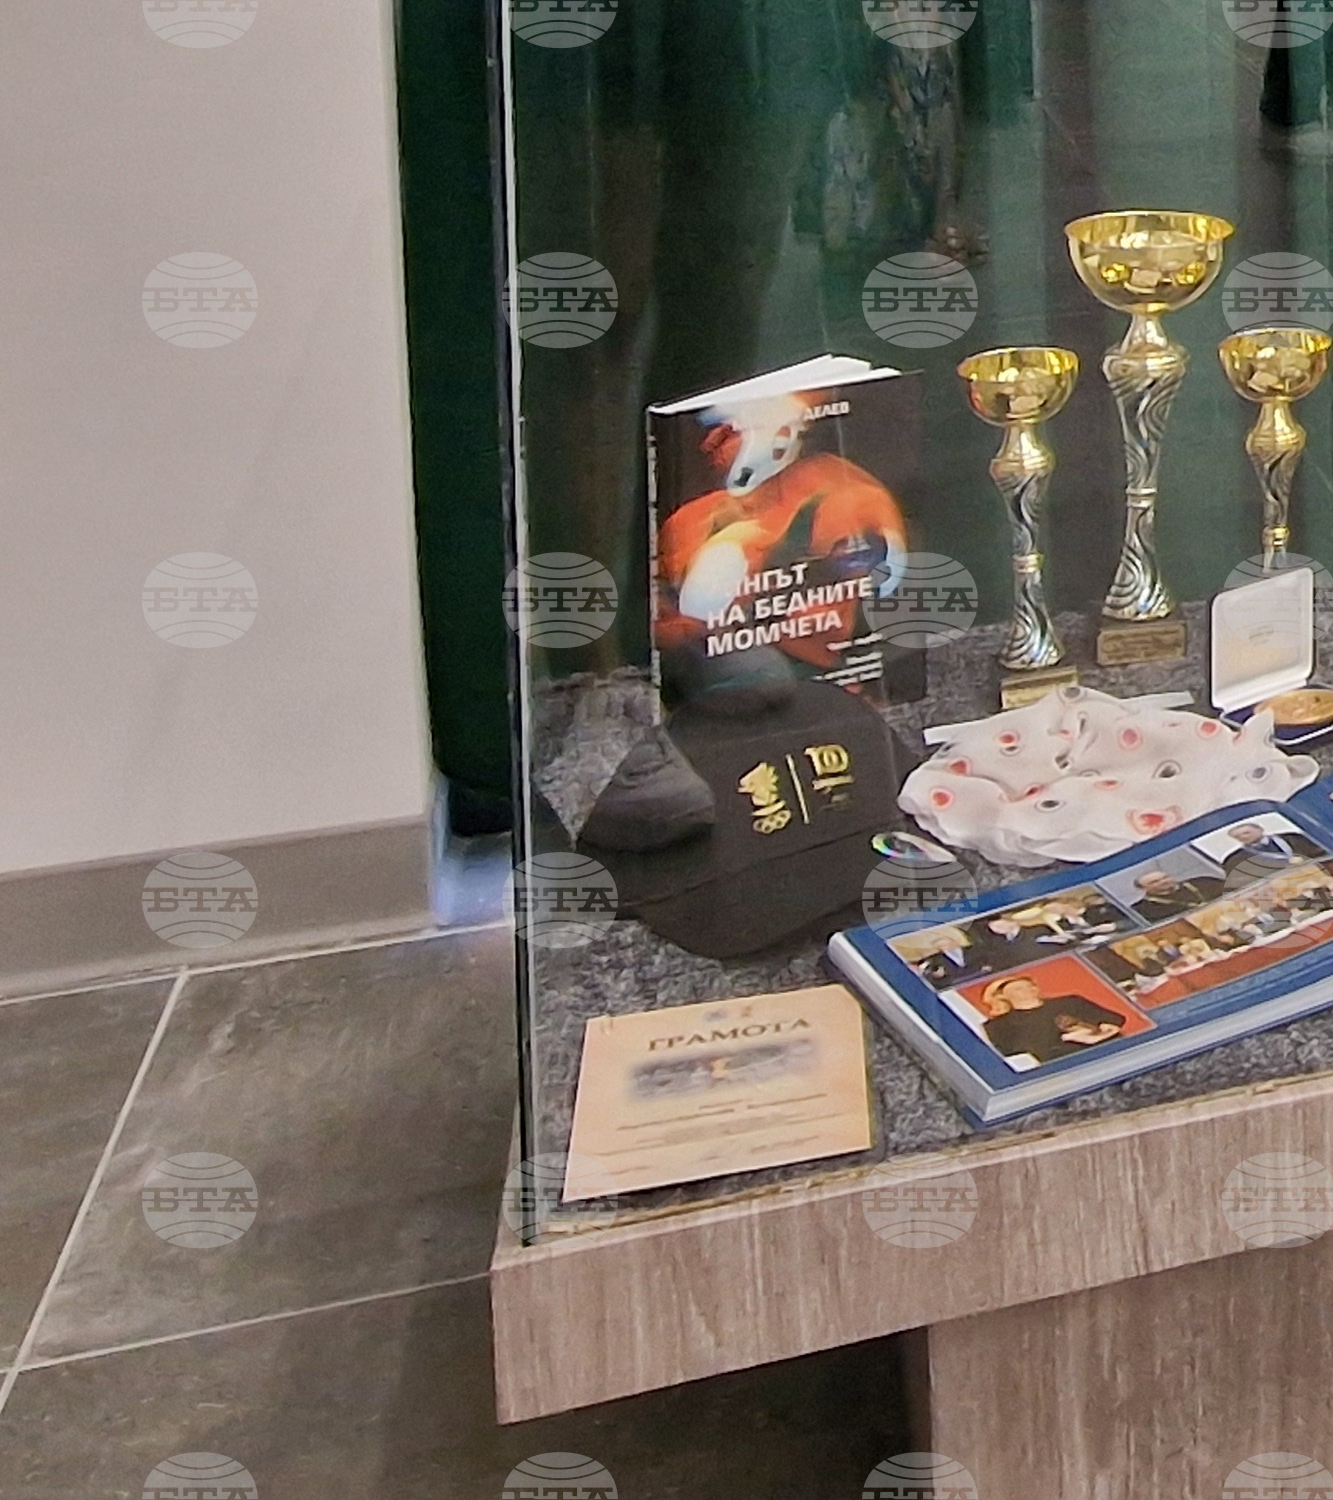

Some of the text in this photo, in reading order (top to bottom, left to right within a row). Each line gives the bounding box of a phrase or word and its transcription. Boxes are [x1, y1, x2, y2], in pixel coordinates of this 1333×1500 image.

[707, 575, 875, 630] НА БЕДНИТЕ
[706, 610, 843, 658] МОМЧЕТА
[648, 1018, 811, 1052] ГРАМОТА
